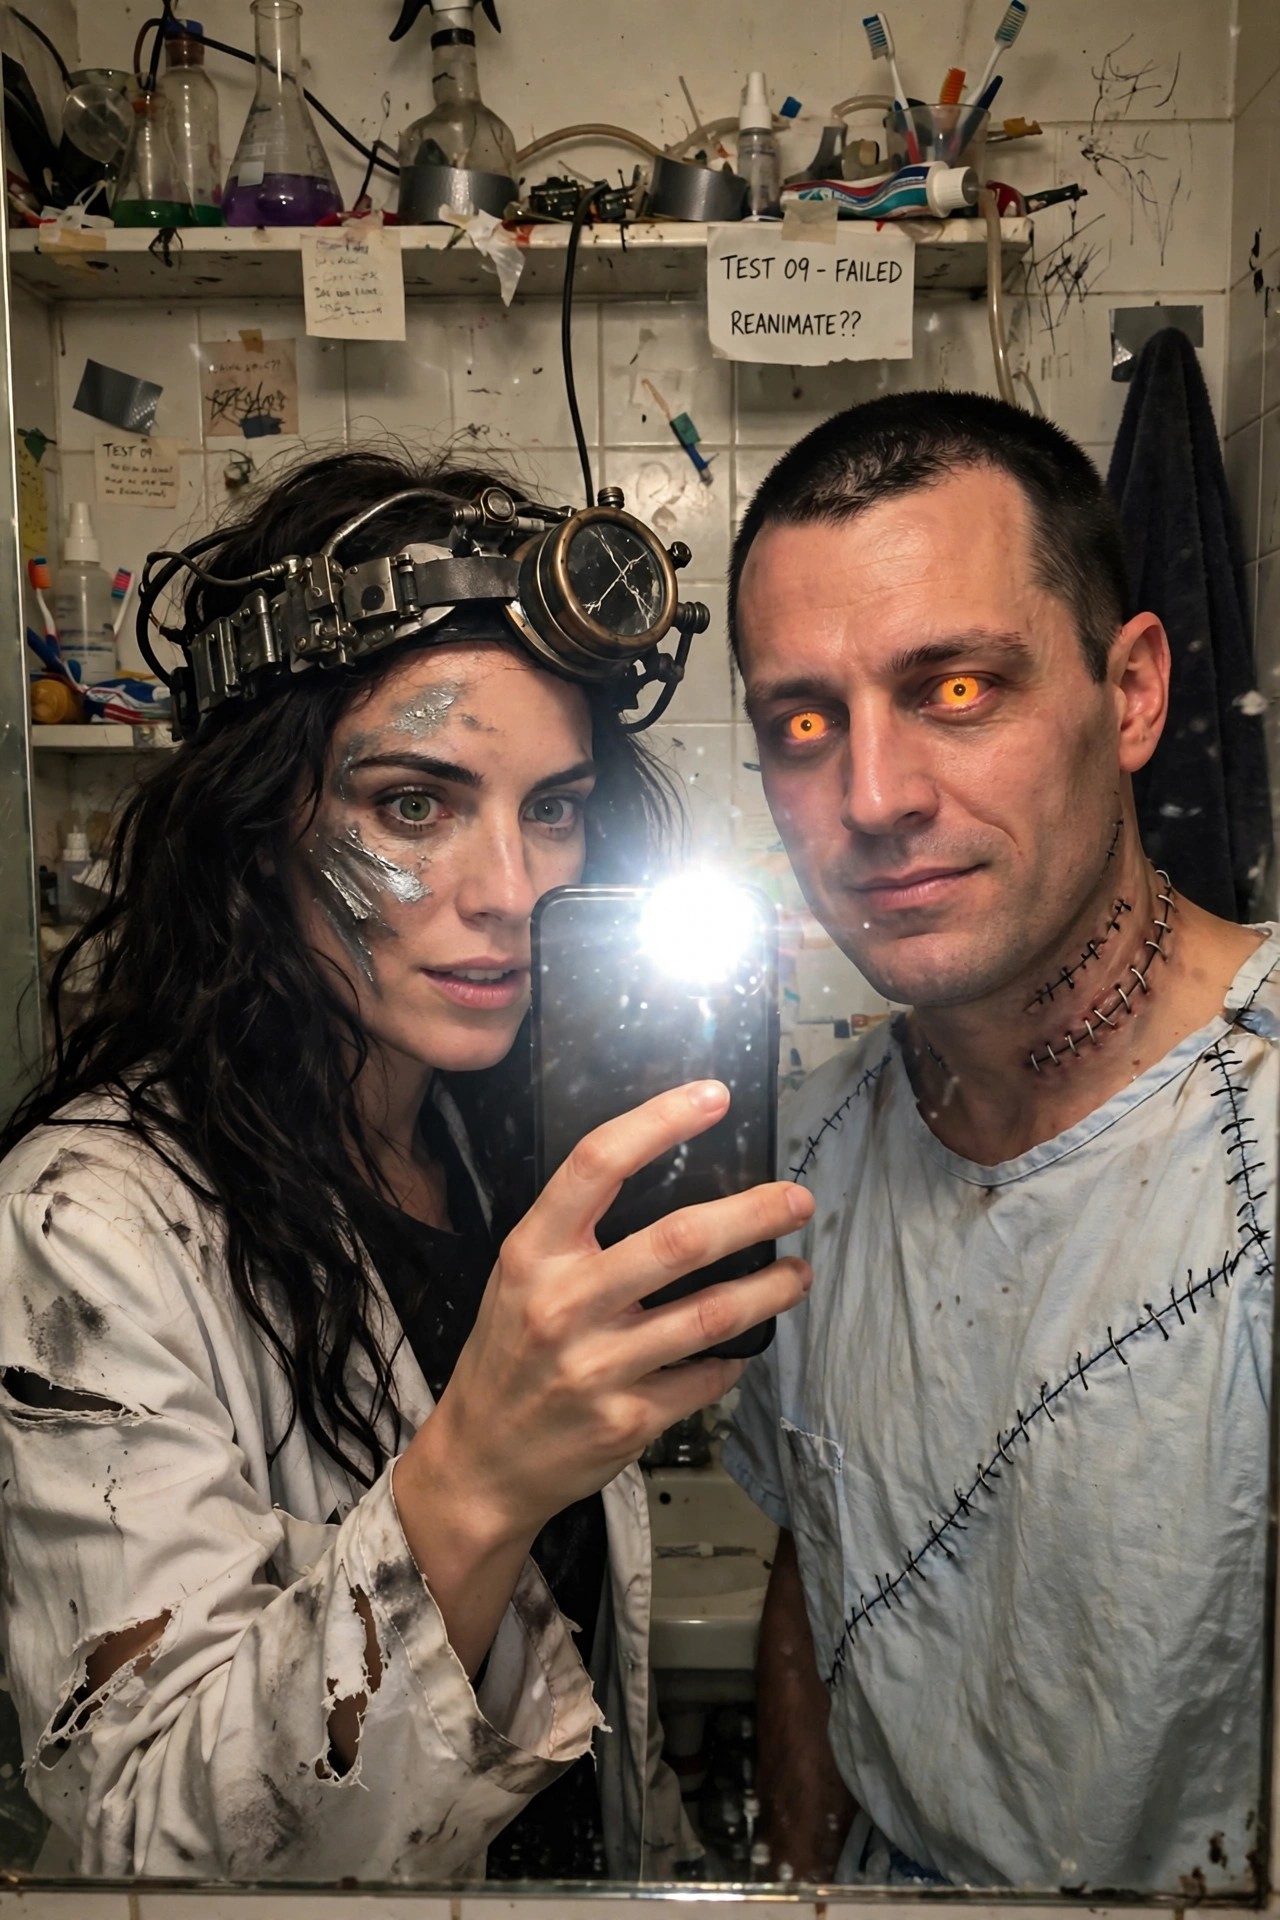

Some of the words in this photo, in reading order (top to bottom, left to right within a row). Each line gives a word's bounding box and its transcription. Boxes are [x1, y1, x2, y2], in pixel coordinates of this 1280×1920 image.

[720, 254, 776, 280] TEST
[784, 256, 810, 282] 09
[835, 258, 903, 284] FAILED
[731, 310, 862, 338] REANIMATE??
[102, 442, 137, 458] TEST
